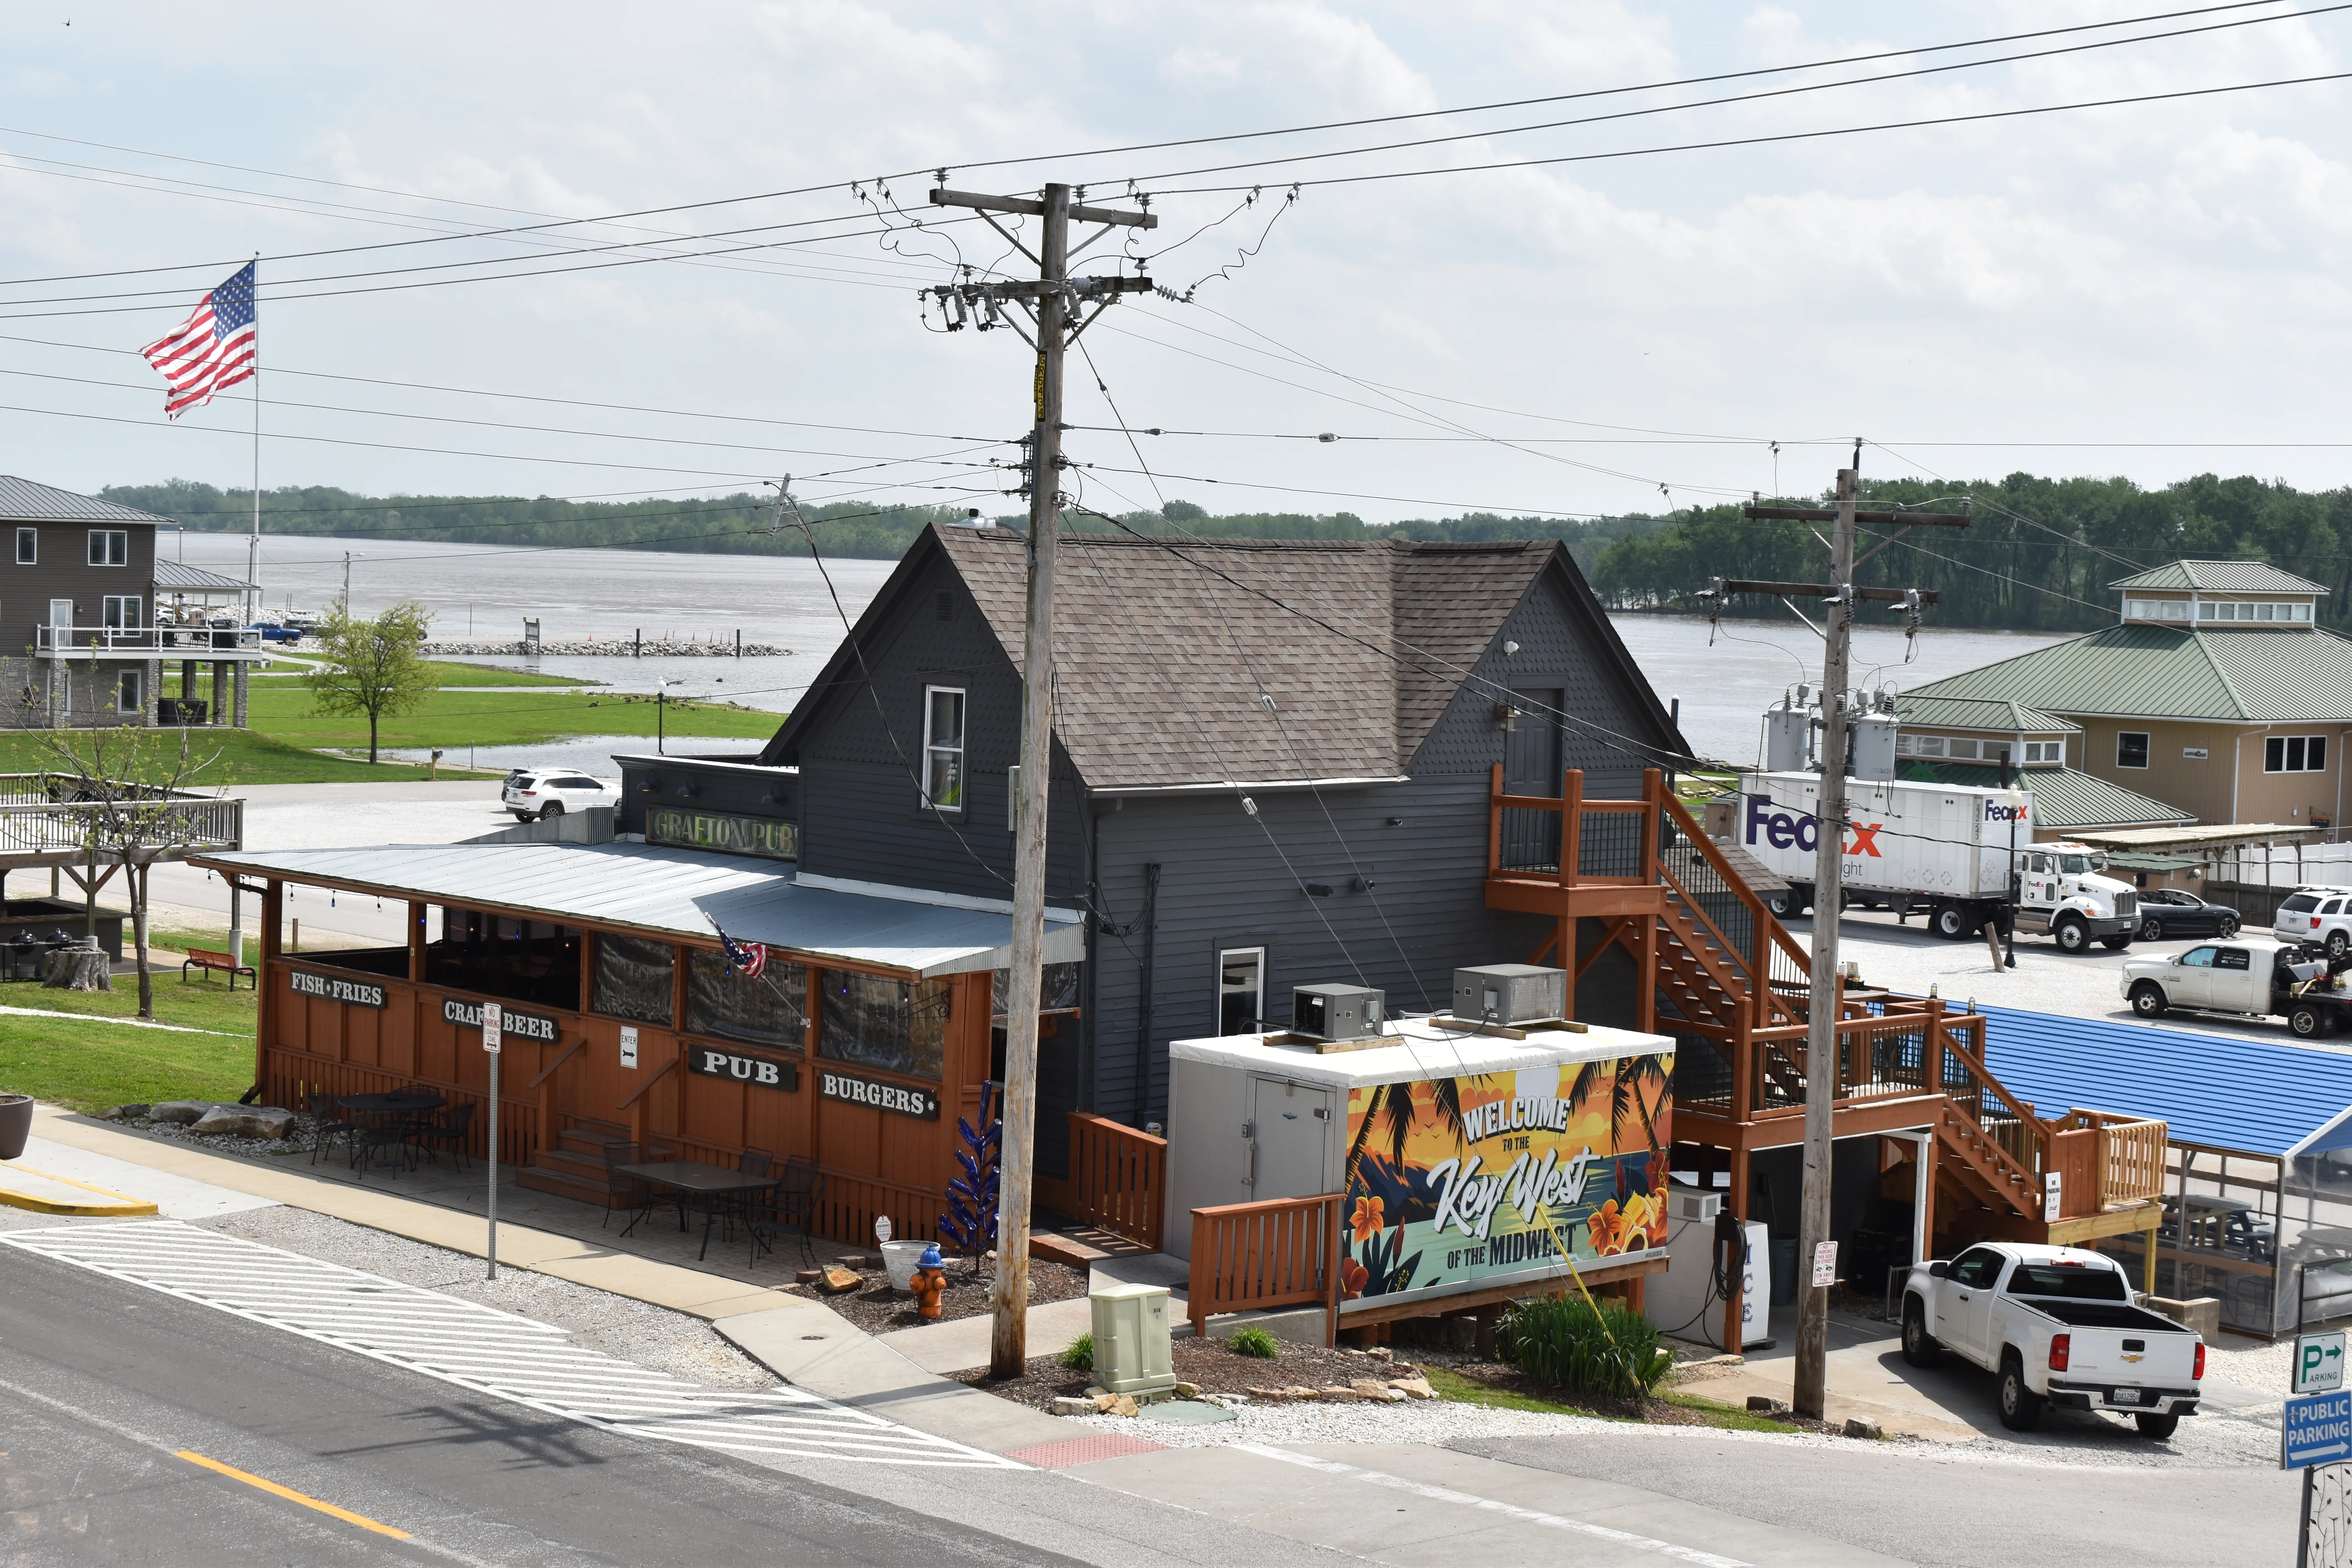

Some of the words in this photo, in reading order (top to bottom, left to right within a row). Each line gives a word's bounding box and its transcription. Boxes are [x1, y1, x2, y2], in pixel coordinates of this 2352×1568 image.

[1746, 793, 1883, 857] Fedx
[1985, 799, 2028, 821] Fedx
[655, 812, 745, 847] GRAFTON
[292, 972, 324, 995] FISH
[332, 980, 382, 1005] FRIES
[445, 1001, 484, 1025] CRAF
[503, 1013, 554, 1039] BEER
[485, 1018, 499, 1028] PARKING
[489, 1008, 495, 1017] NO
[622, 1035, 637, 1045] ENTER
[704, 1051, 779, 1083] PUB
[824, 1074, 924, 1114] BURGERS
[1462, 1096, 1571, 1146] WELCOME
[1503, 1139, 1512, 1152] TO
[1515, 1136, 1529, 1150] THE
[1426, 1155, 1501, 1242] Key
[1497, 1145, 1603, 1225] West
[1447, 1250, 1461, 1269] OF
[1464, 1246, 1485, 1266] THE
[1489, 1223, 1576, 1266] MIDWEST
[2114, 1392, 2136, 1401] 4041295
[2299, 1399, 2348, 1423] PUBLIC
[2288, 1421, 2349, 1446] PARKING
